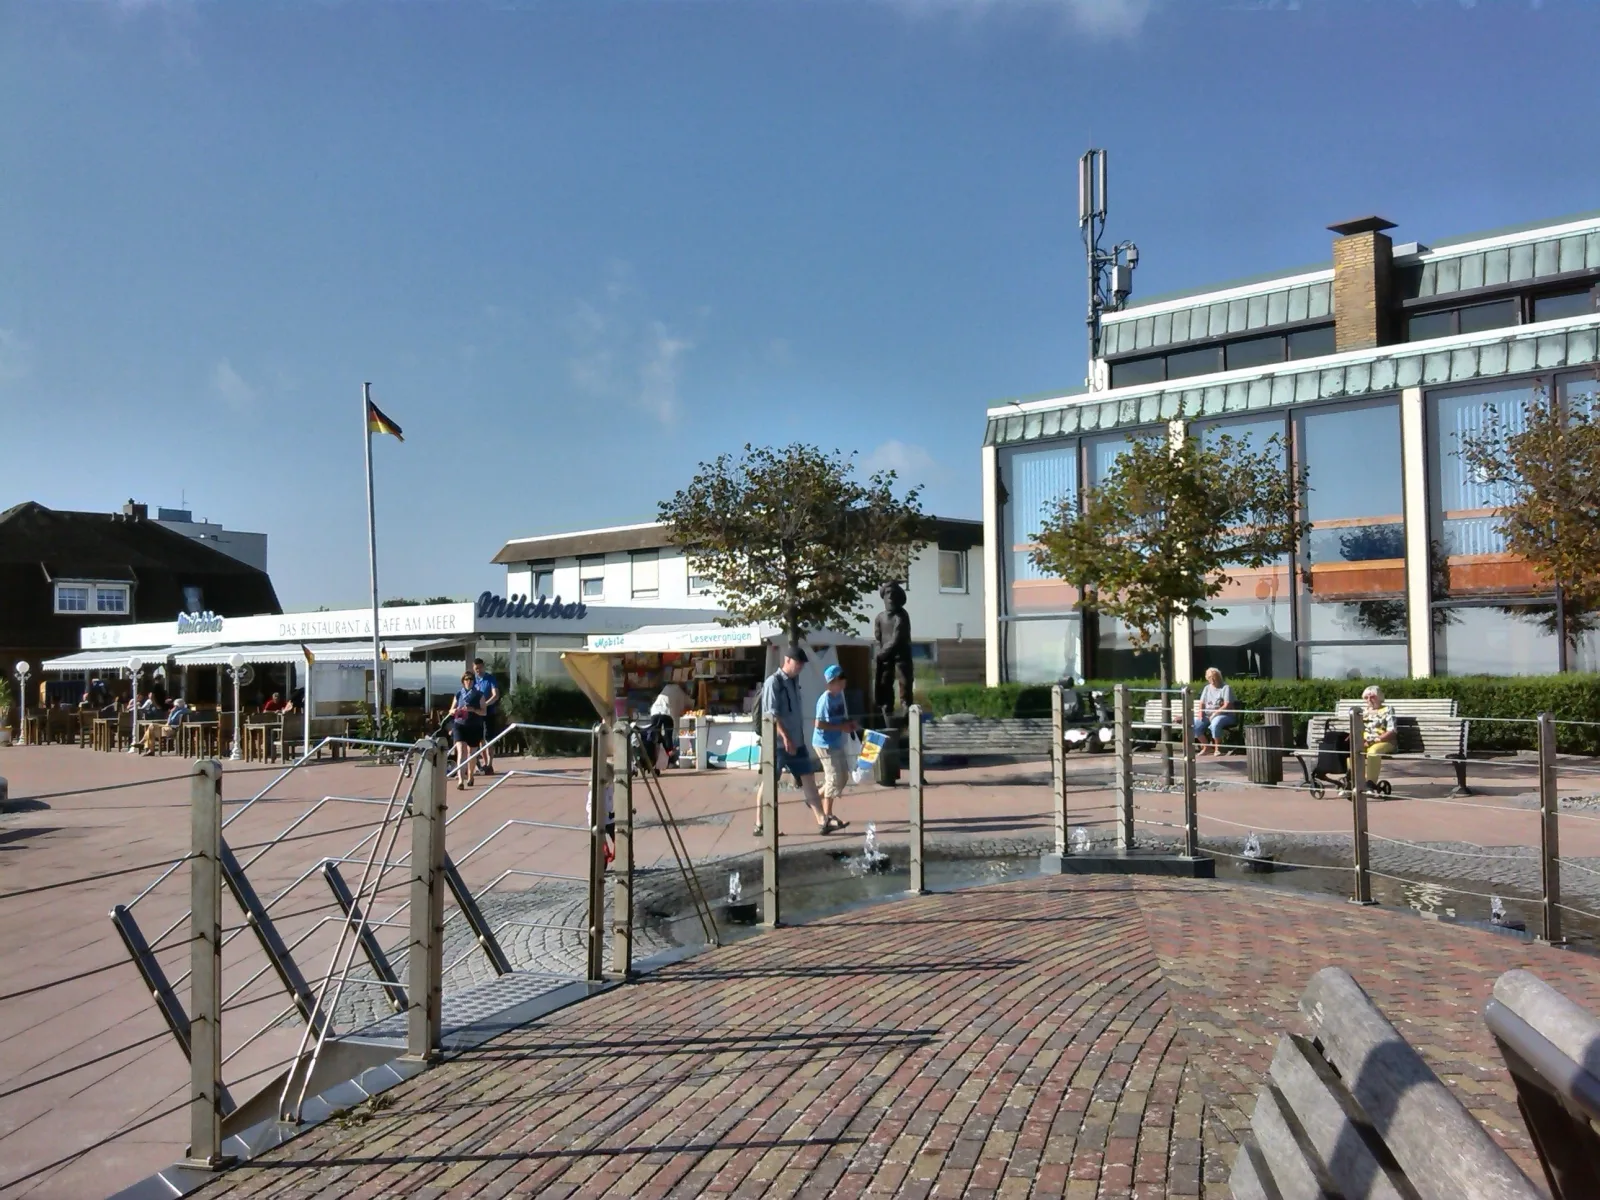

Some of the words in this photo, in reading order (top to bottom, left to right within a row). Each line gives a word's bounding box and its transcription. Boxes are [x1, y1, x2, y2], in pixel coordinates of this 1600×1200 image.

[477, 591, 588, 620] Milchbar
[279, 623, 297, 637] DAS
[301, 620, 360, 636] RESTAURANT
[364, 619, 371, 633] &
[405, 616, 421, 631] AM
[426, 614, 456, 629] MEER
[690, 632, 752, 644] Lesevergnügen
